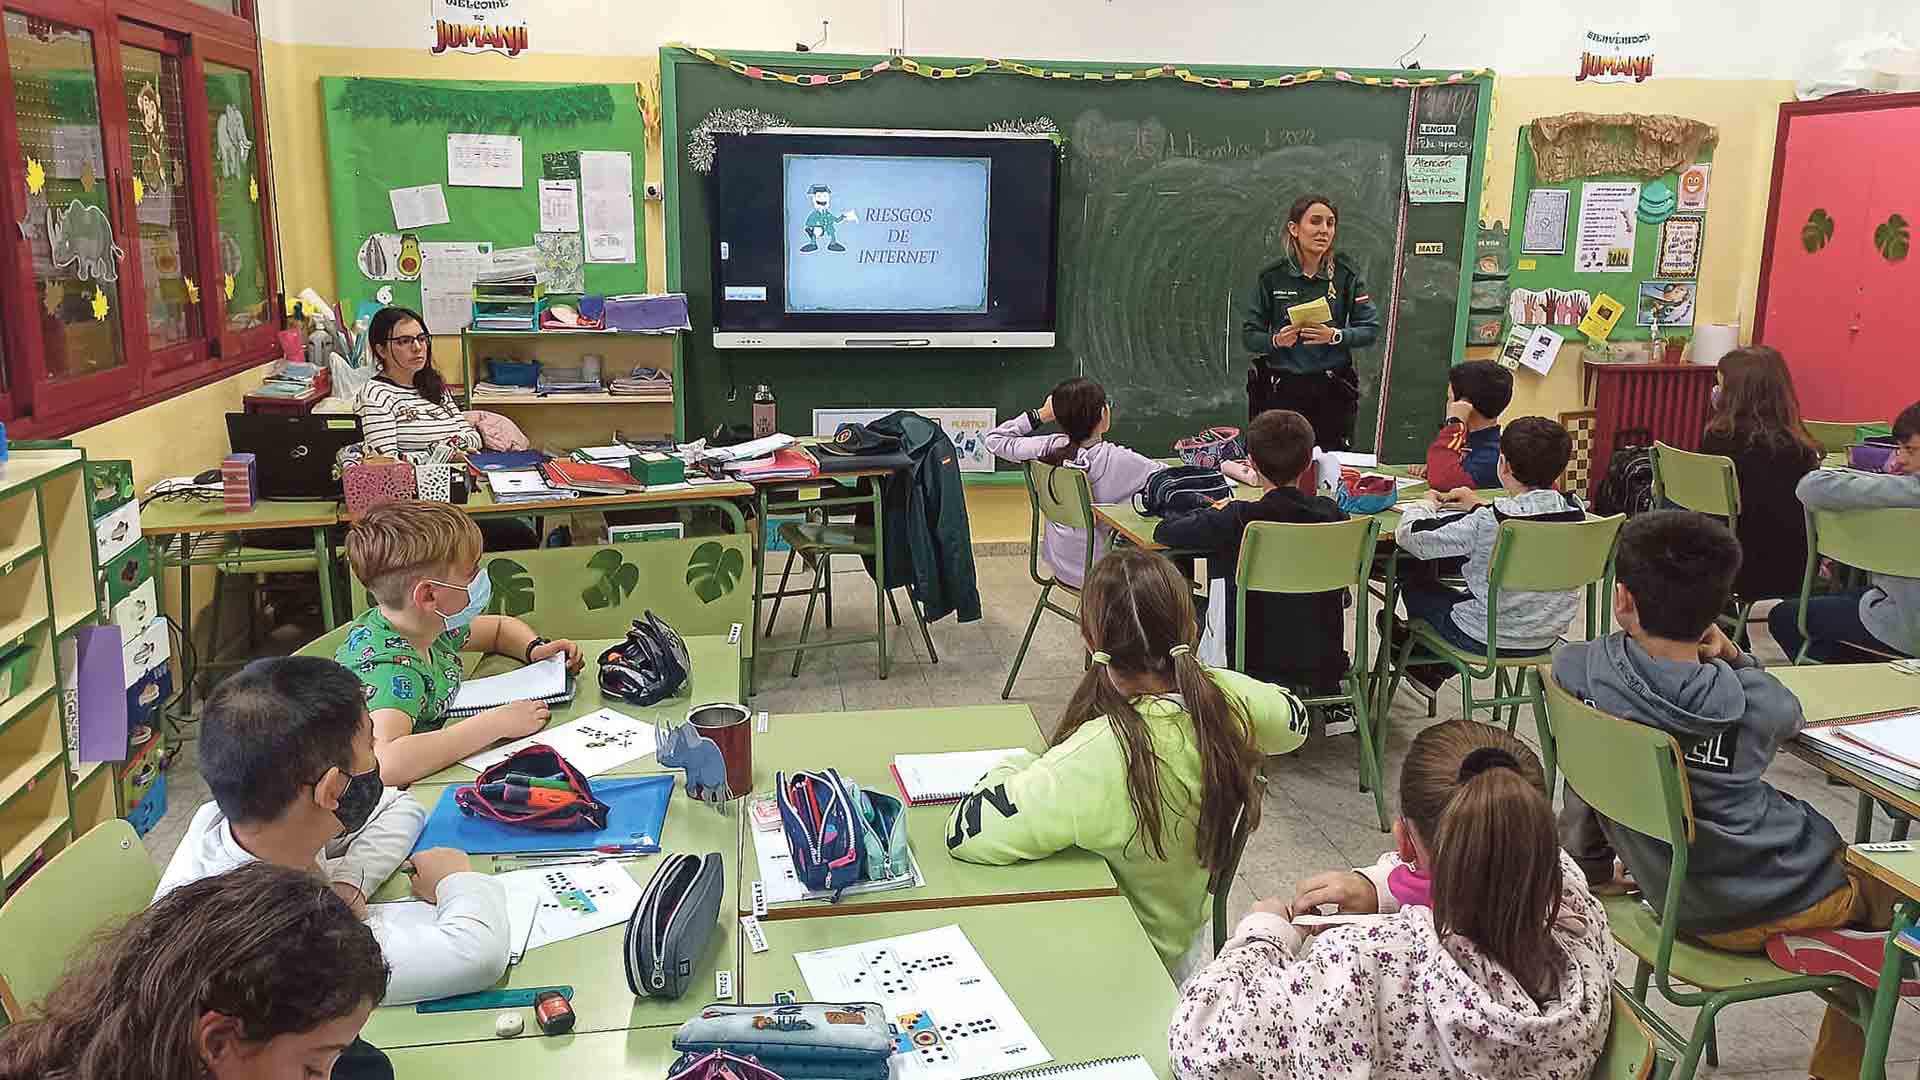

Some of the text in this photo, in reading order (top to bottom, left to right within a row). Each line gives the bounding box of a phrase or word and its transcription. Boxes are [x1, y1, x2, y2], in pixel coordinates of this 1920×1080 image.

[432, 19, 528, 56] JUMANJI
[1576, 52, 1653, 82] JUMANJI
[1420, 125, 1455, 134] LENGUA
[865, 208, 933, 223] RIESGOS
[887, 229, 909, 243] DE
[858, 249, 939, 264] INTERNET
